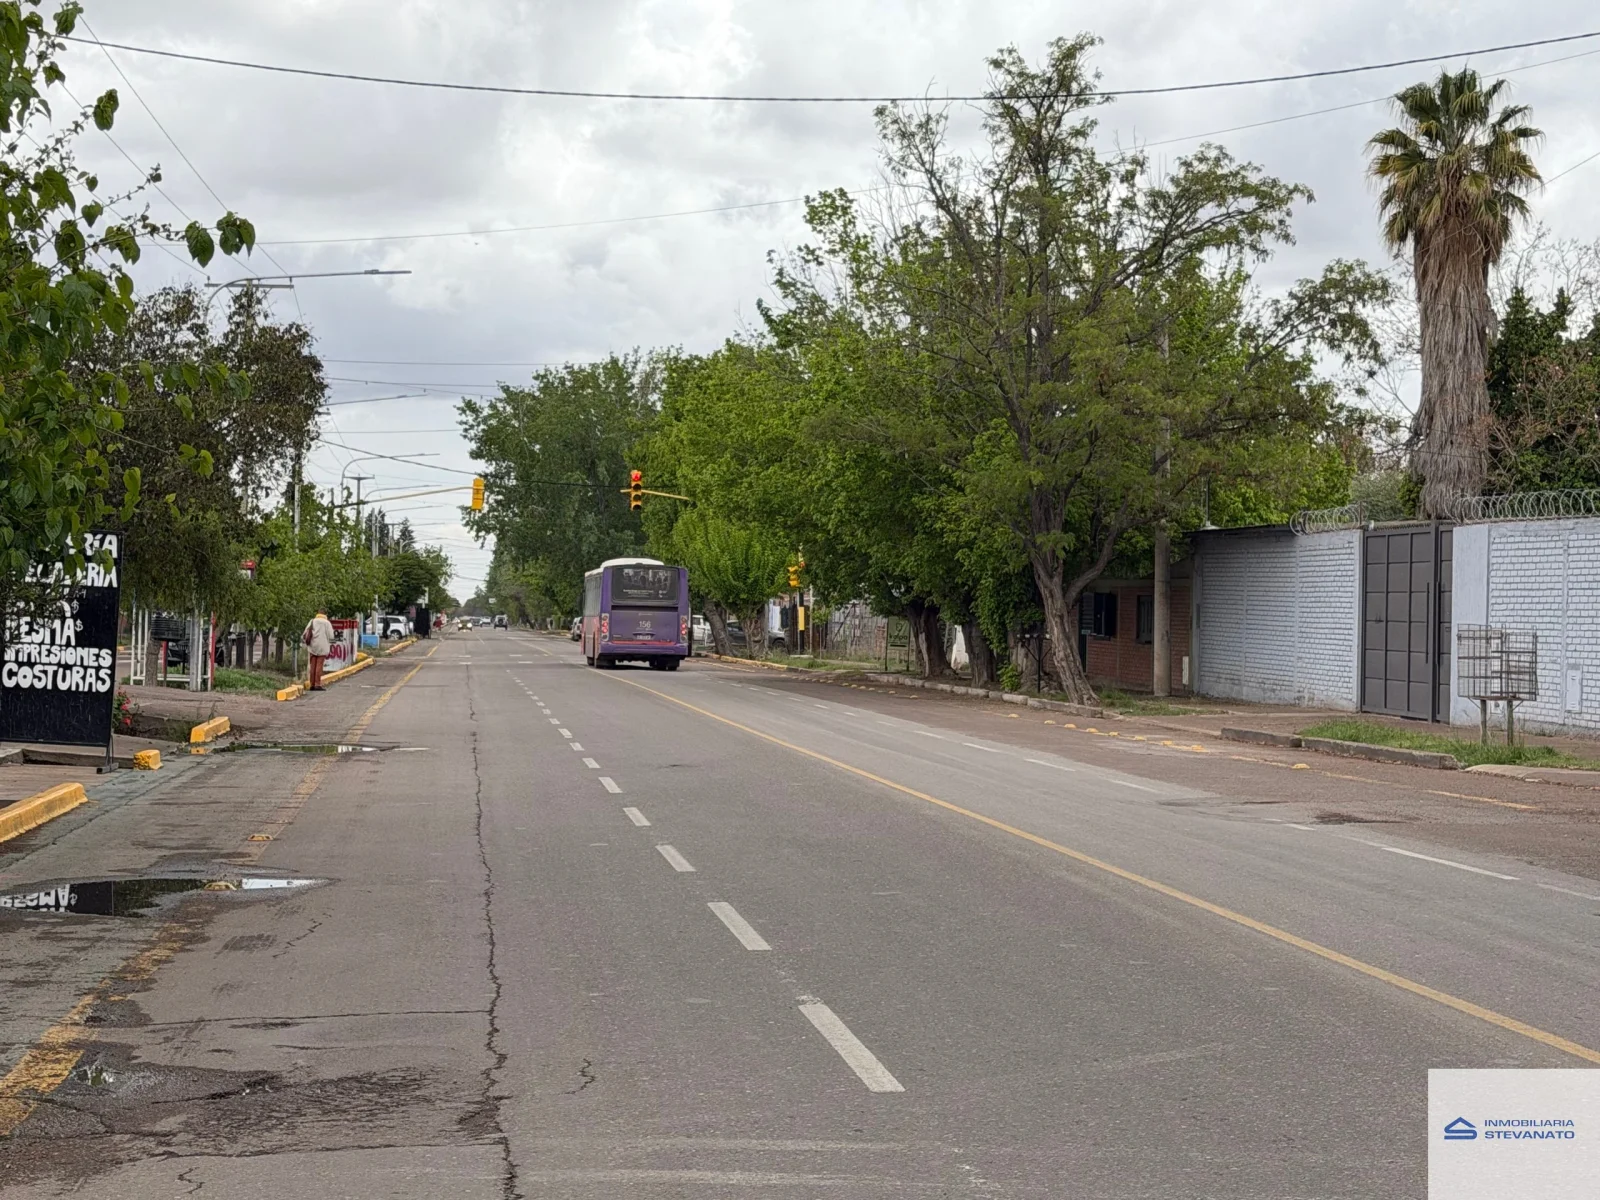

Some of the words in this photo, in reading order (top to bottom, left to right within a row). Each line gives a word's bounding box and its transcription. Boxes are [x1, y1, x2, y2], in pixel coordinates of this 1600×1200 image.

[75, 618, 84, 632] $
[639, 620, 651, 628] 156
[2, 662, 111, 692] COSTURAS
